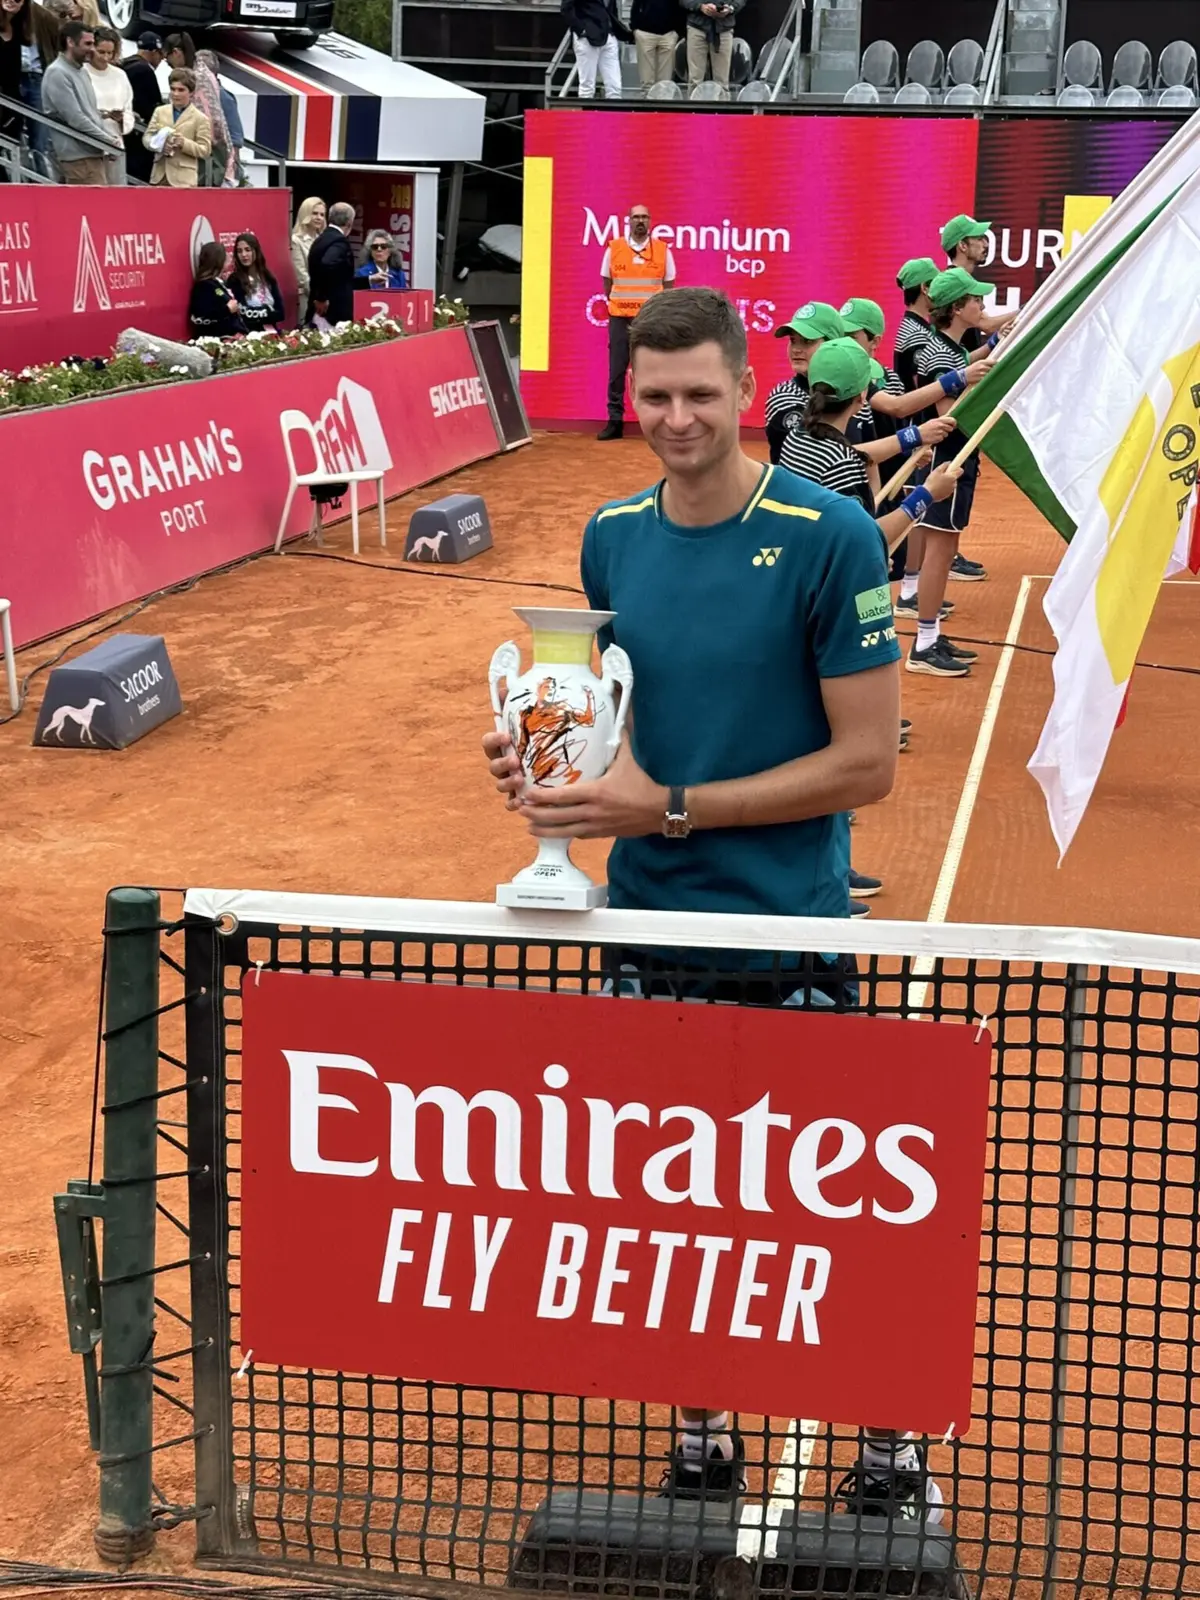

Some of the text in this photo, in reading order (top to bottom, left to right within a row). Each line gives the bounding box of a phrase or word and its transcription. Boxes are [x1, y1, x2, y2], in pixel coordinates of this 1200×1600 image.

[582, 206, 791, 253] Miennium
[104, 233, 166, 267] ANTHEA
[726, 254, 766, 279] bcp
[109, 270, 145, 290] SECURITY
[82, 419, 243, 511] GRAHAM'S
[160, 499, 208, 537] PORT
[457, 512, 483, 536] SACOOR
[120, 660, 163, 703] SACOOR
[280, 1049, 938, 1225] Emirates
[377, 1208, 832, 1345] FLY BETTER
